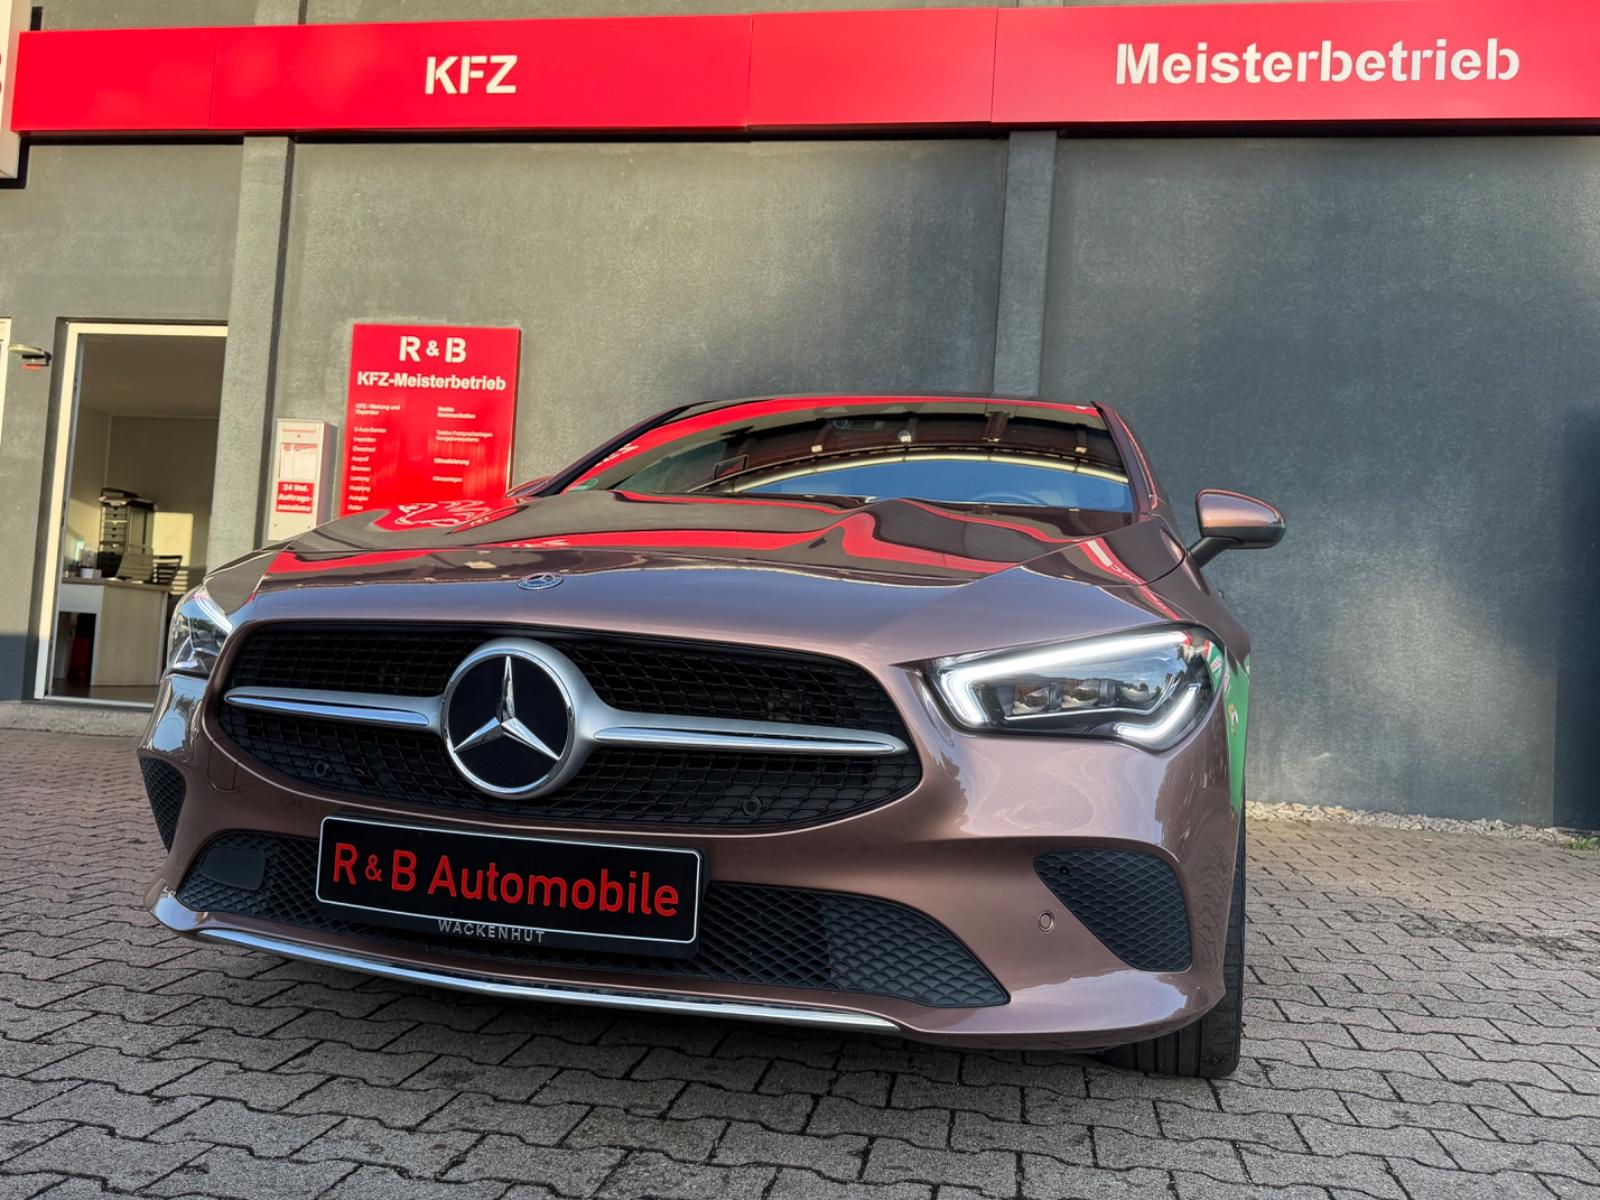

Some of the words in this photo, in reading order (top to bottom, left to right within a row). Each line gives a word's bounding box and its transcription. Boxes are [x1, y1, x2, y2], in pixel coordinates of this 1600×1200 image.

[425, 55, 518, 94] KFZ
[1116, 38, 1520, 85] Meisterbetrieb
[399, 336, 421, 362] R
[426, 340, 439, 357] &
[445, 337, 466, 363] B
[357, 371, 506, 391] KFZ-Meisterbetrieb
[333, 843, 358, 885] R
[365, 854, 382, 882] &
[391, 849, 417, 892] B
[428, 855, 679, 917] Automobile
[438, 919, 545, 944] WACKENHUT
